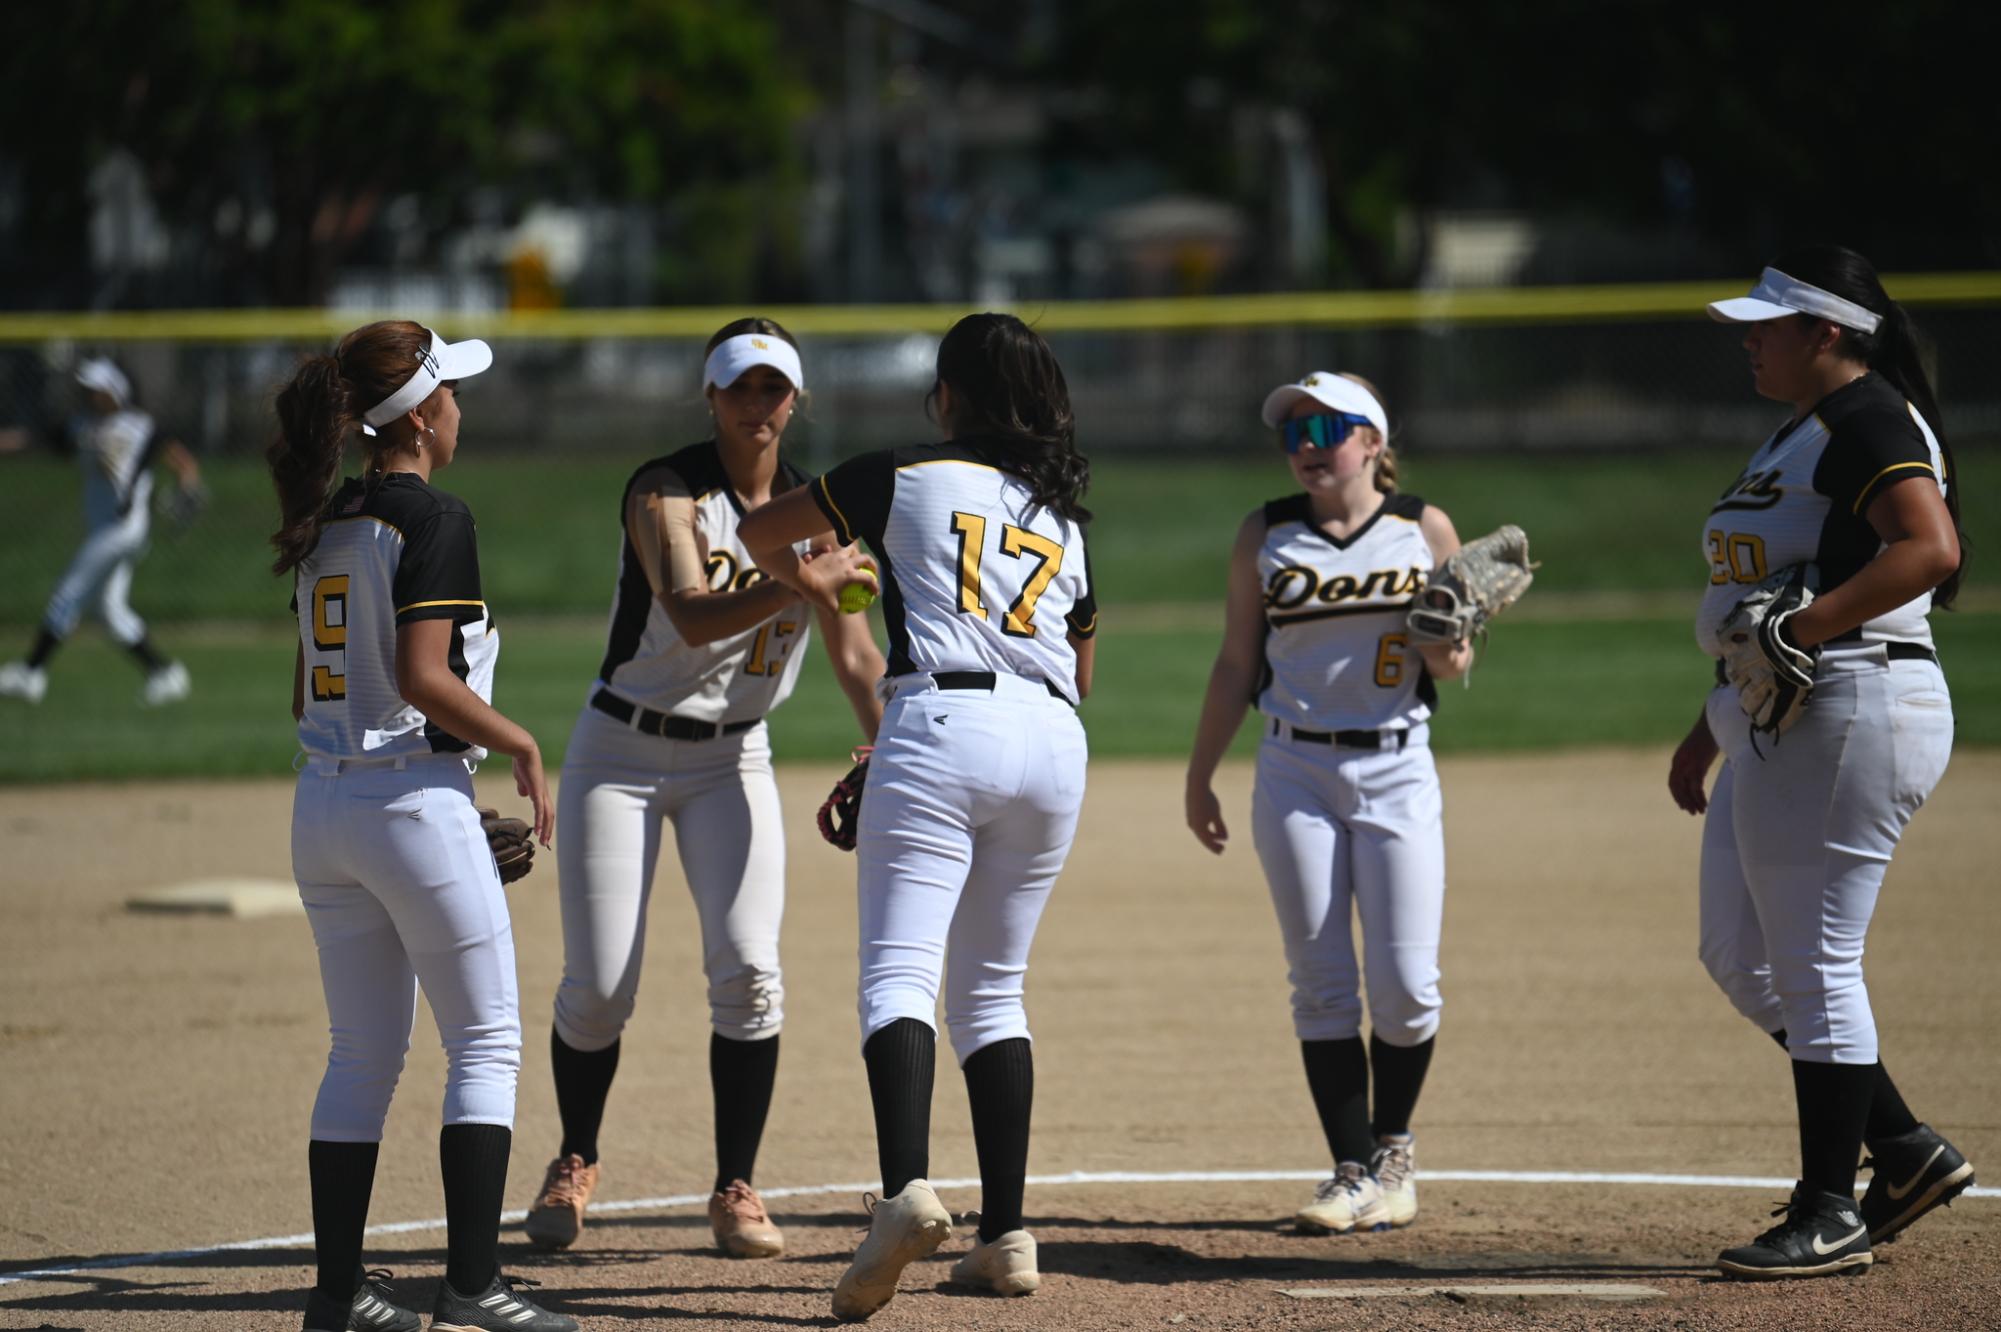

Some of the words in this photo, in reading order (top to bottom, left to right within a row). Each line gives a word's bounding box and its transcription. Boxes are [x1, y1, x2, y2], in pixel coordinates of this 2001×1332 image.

[950, 510, 1064, 638] 17
[1708, 529, 1769, 586] 20
[1264, 565, 1427, 610] Dons
[312, 574, 350, 702] 9
[1374, 633, 1409, 688] 6
